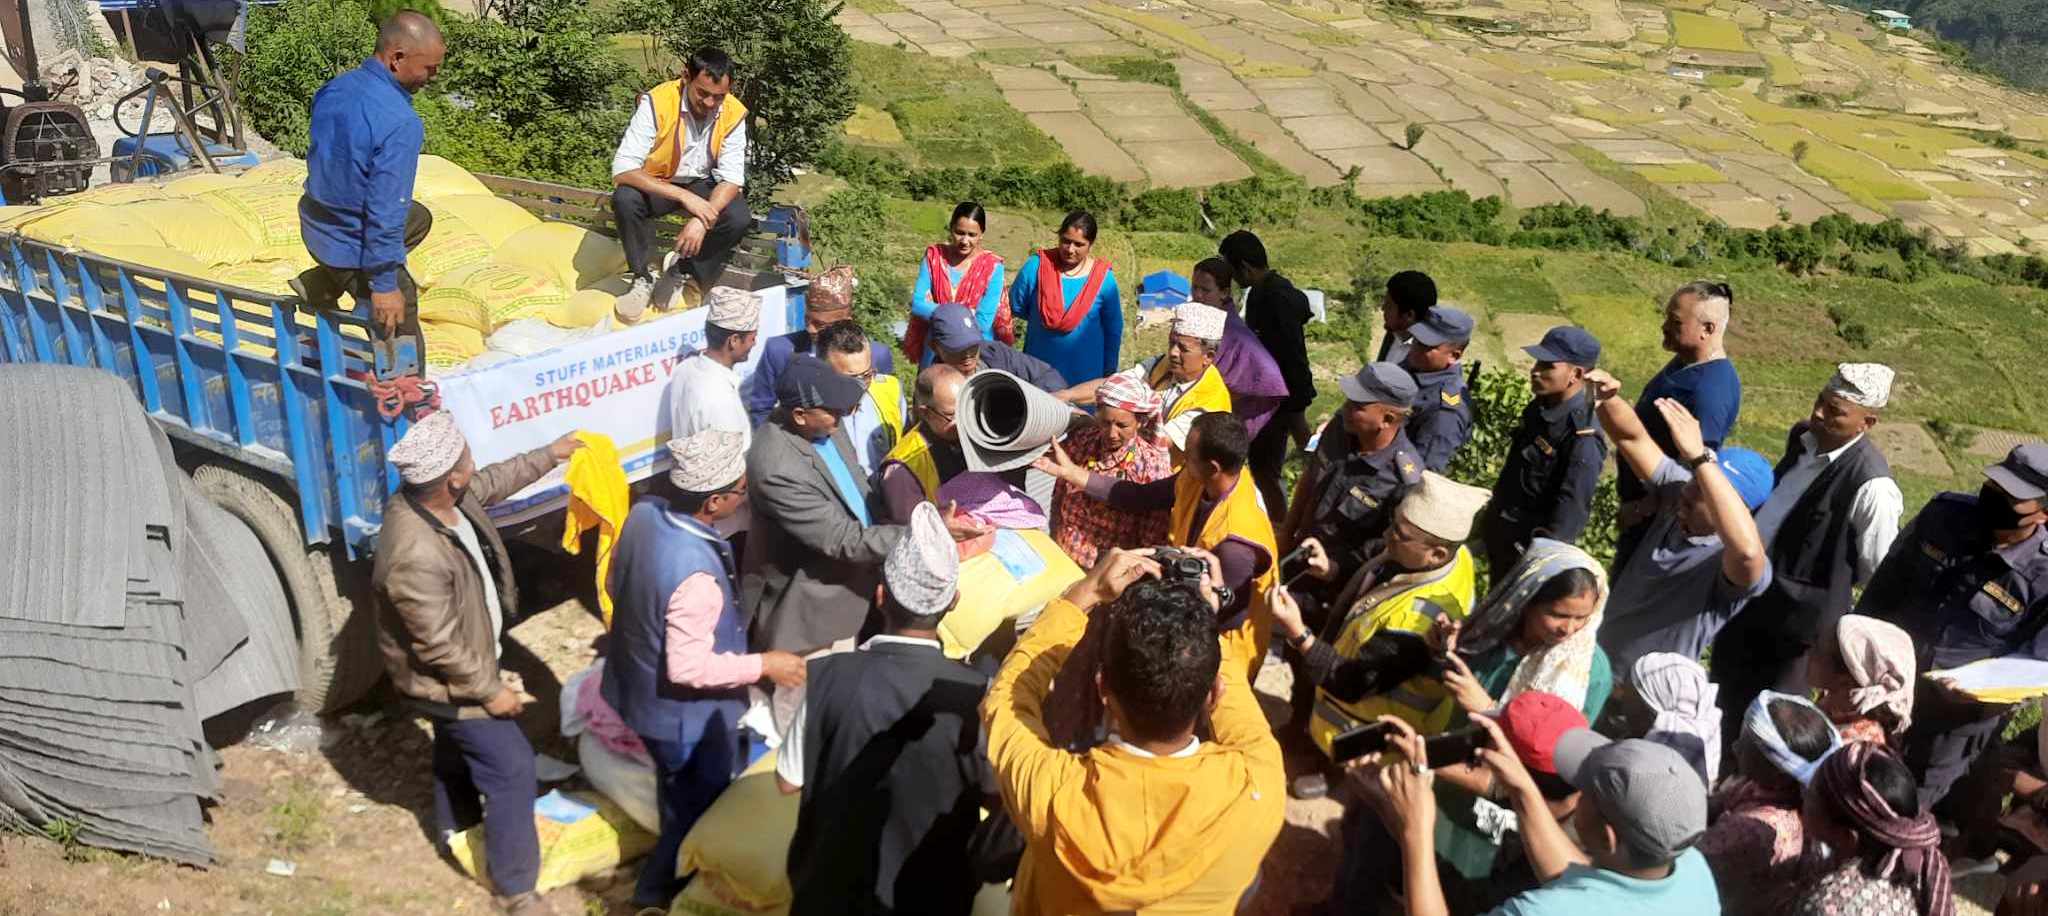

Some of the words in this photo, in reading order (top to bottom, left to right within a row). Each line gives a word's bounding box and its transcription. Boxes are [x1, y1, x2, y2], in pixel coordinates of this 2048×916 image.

[535, 361, 587, 387] STUFF
[592, 336, 677, 370] MATERIALS
[489, 362, 657, 430] EARTHQUAKE
